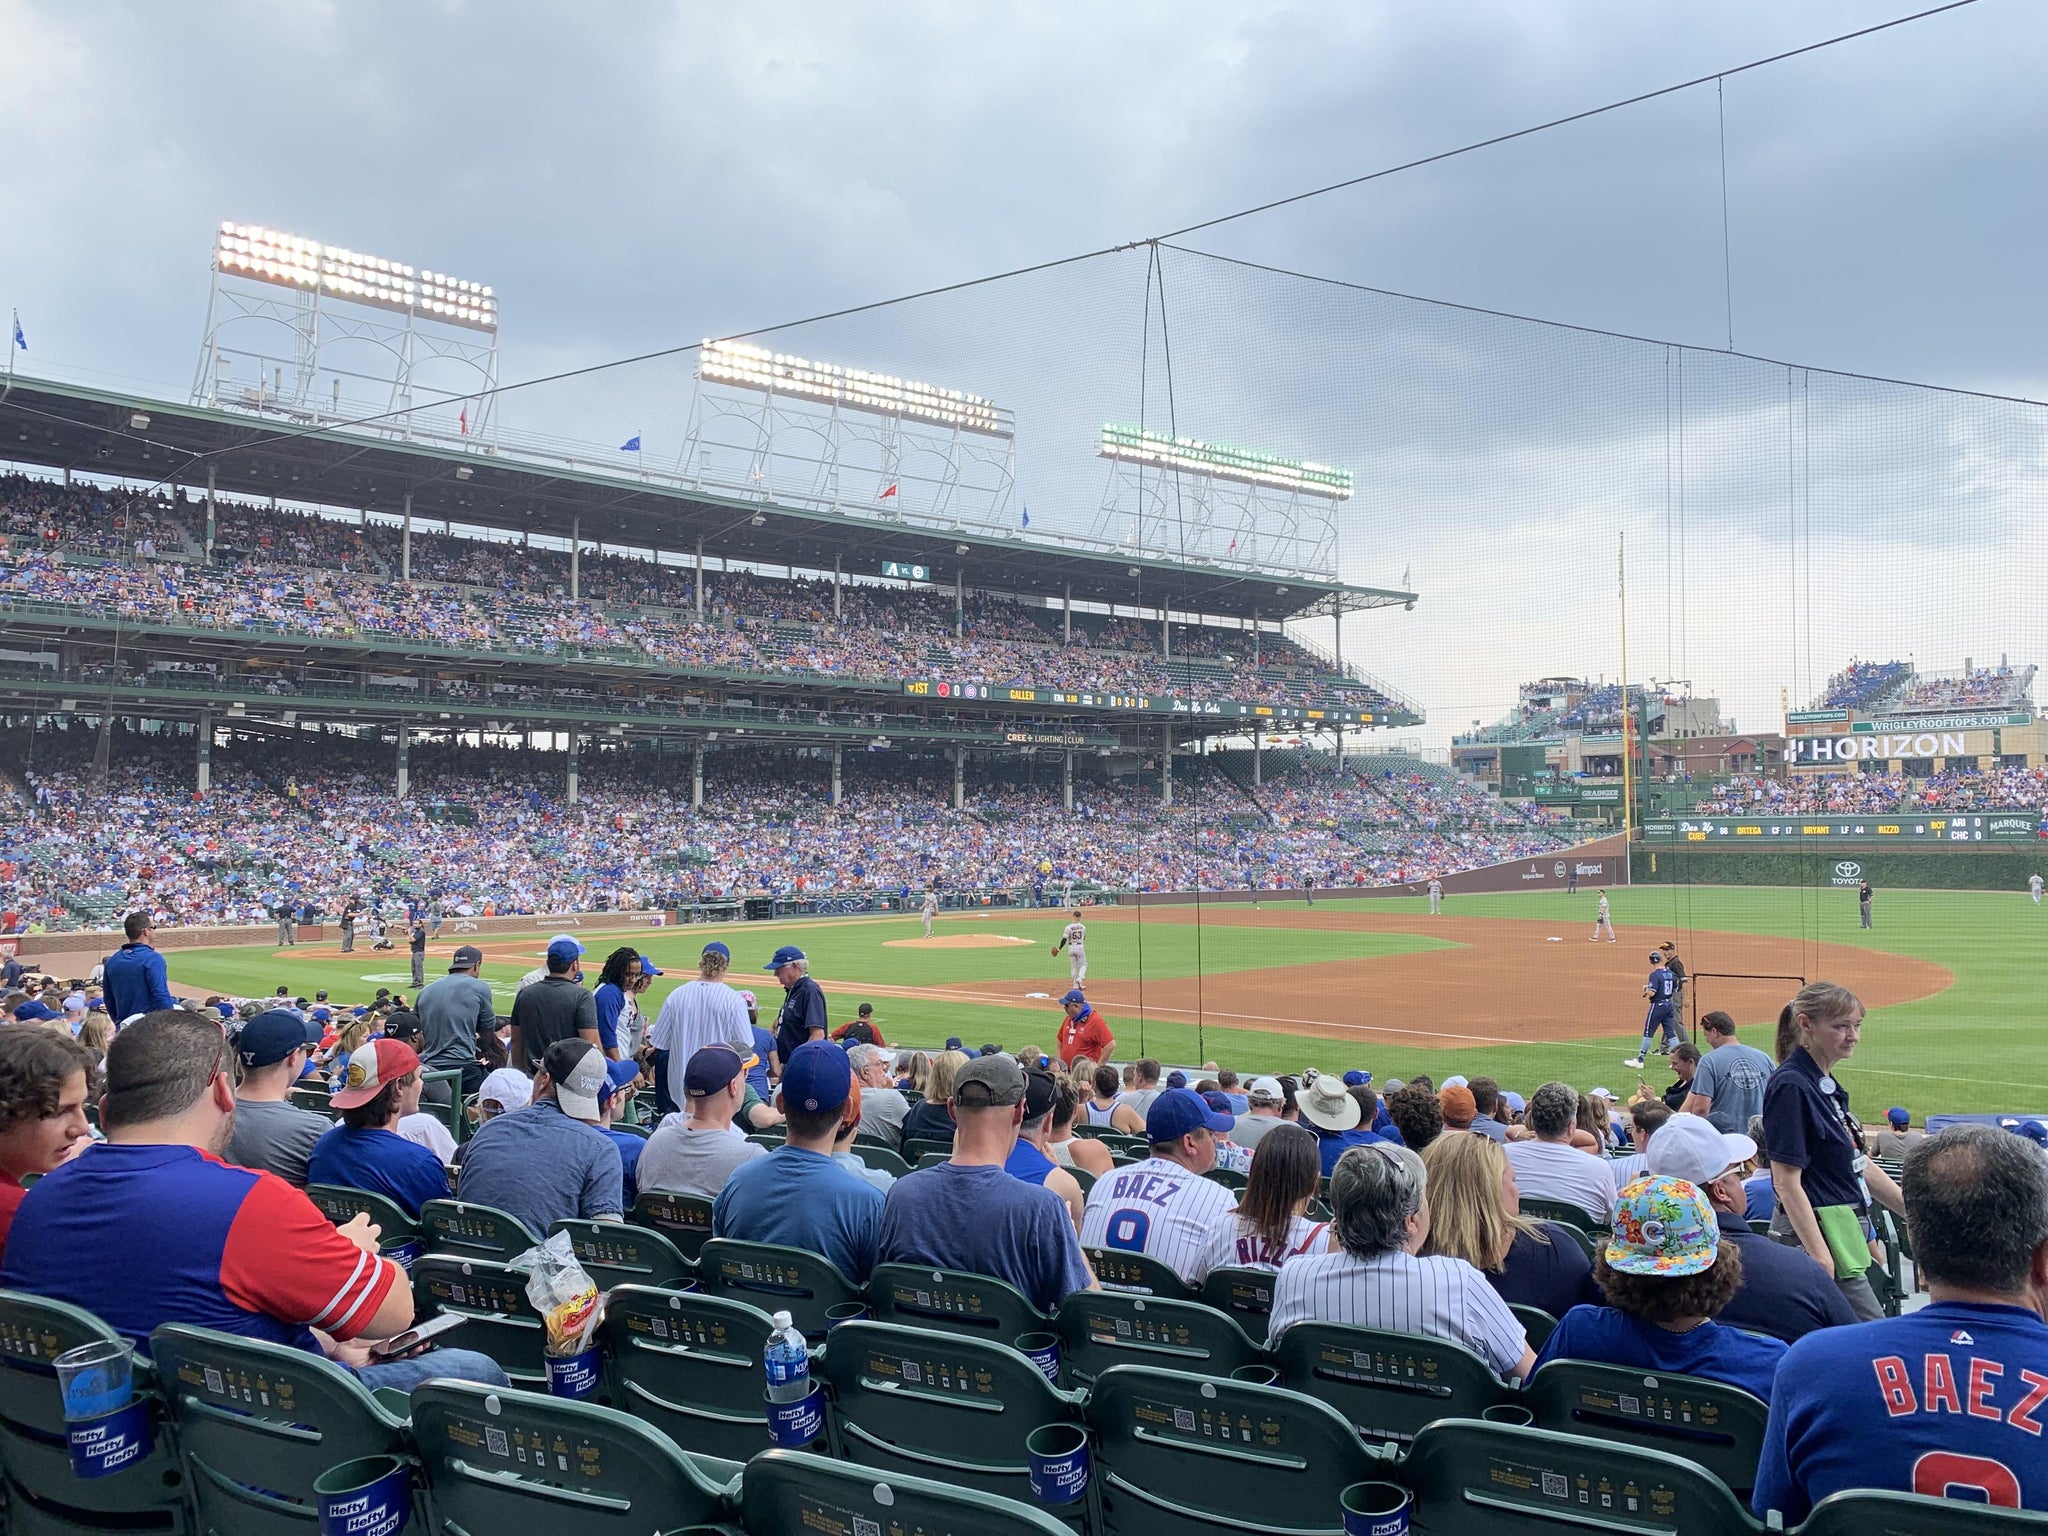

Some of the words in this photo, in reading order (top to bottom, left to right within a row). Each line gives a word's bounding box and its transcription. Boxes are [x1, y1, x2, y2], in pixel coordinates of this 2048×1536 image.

[954, 685, 960, 696] 0
[981, 686, 987, 698] 0
[1010, 689, 1035, 701] GALLEN
[1054, 694, 1065, 702] ERA
[1173, 700, 1188, 711] Due
[1192, 701, 1201, 713] Up
[1205, 702, 1221, 713] Cubs
[1872, 715, 2009, 731] WRIGLEYROOFTOPS.COM
[1007, 733, 1027, 742] CREE
[1035, 735, 1063, 743] LIGHTING
[1067, 736, 1085, 745] CLUB
[1811, 732, 1965, 761] HORIZON
[1581, 789, 1620, 797] GRAINGER
[1680, 822, 1698, 832] Due
[1702, 821, 1714, 835] Up
[1930, 821, 1947, 830] BOT
[1952, 817, 1967, 828] ARI
[1975, 817, 1982, 827] 0
[1989, 818, 2033, 832] MARQUEE
[1737, 826, 1762, 835] ORTEGA
[1772, 826, 1781, 835] CF
[1785, 826, 1793, 835] 17
[1803, 826, 1830, 835] BRYANT
[1841, 825, 1850, 834] LF
[1855, 825, 1864, 834] 44
[1878, 825, 1900, 834] RIZZO
[1951, 831, 1968, 840] CHC
[1975, 831, 1982, 840] 0
[242, 1051, 256, 1066] Y
[1112, 1174, 1182, 1208] BAEZ
[554, 1363, 577, 1373] Hefty
[565, 1372, 588, 1383] Hefty
[577, 1378, 596, 1391] Hefty
[1873, 1353, 2048, 1437] BAEZ
[780, 1408, 804, 1419] Hefty
[793, 1414, 815, 1429] Hefty
[72, 1430, 104, 1443] Hefty
[88, 1437, 122, 1456] Hefty
[106, 1446, 138, 1466] Hefty
[1044, 1463, 1072, 1474] Hefty
[1059, 1471, 1081, 1485] Hefty
[331, 1500, 366, 1516] Hefty
[349, 1509, 385, 1530] Hefty
[369, 1515, 399, 1536] Hefty
[1373, 1521, 1401, 1536] Hefty
